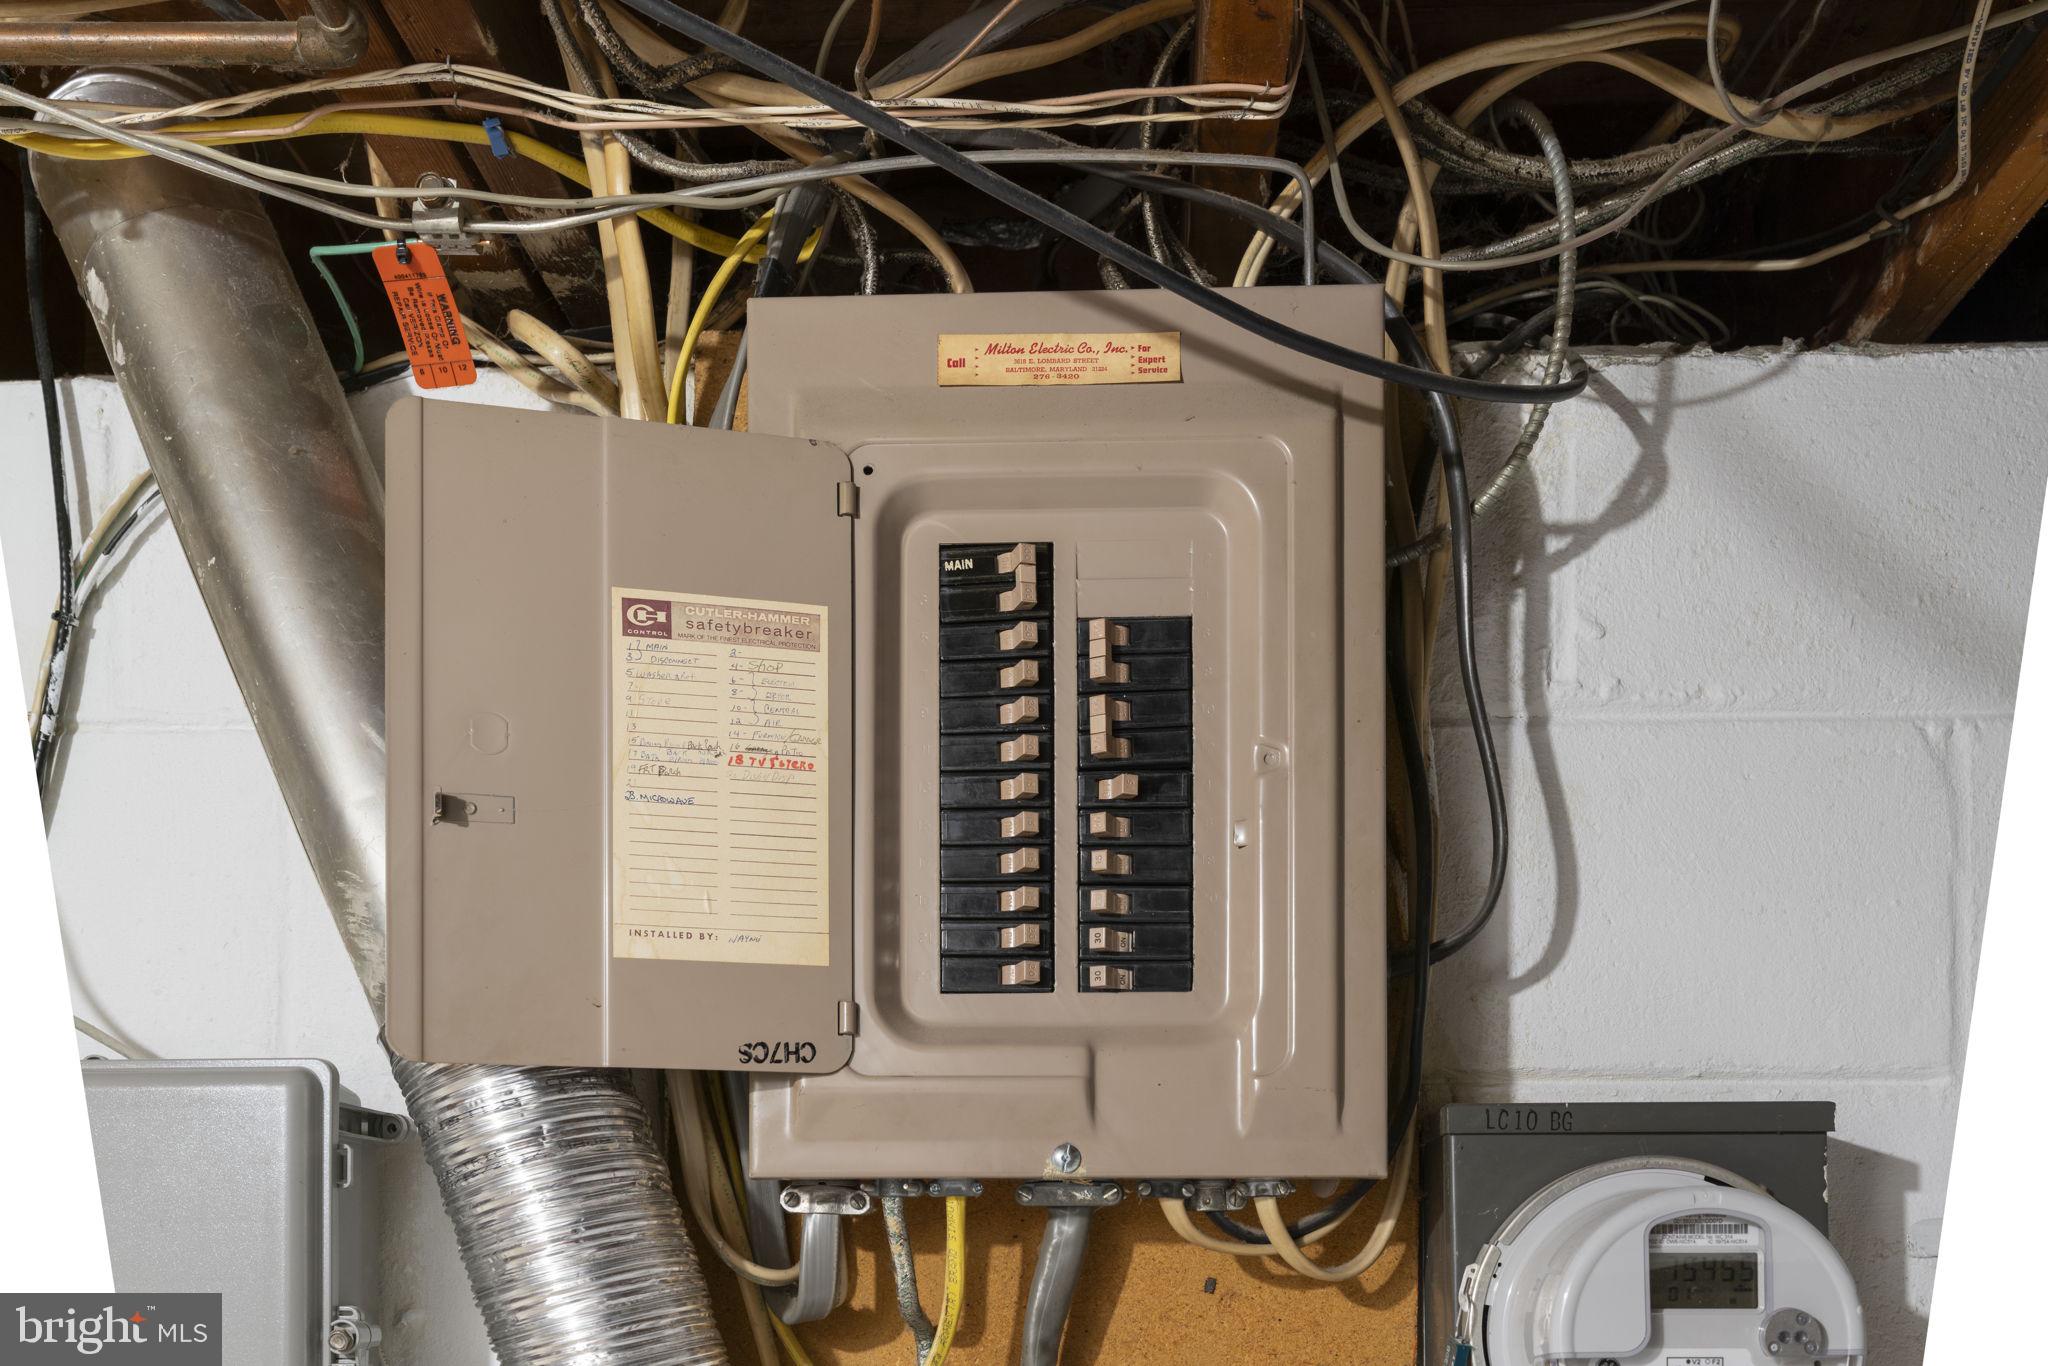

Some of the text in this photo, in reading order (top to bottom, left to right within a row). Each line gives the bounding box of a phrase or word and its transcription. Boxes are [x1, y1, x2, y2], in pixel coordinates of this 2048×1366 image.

[412, 298, 427, 331] Removed
[437, 293, 461, 346] WARNING
[391, 290, 419, 357] REPAIR SERVICE
[408, 313, 424, 348] VERIZON
[984, 342, 1129, 356] Milton Electric Co., Inc.
[1138, 344, 1151, 353] For
[947, 358, 966, 368] Call
[1138, 355, 1166, 366] Expert
[438, 366, 449, 374] 10
[457, 364, 468, 372] 12
[1138, 365, 1168, 374] Service
[944, 559, 974, 572] MAIN
[685, 606, 811, 627] CUTLER-HAMMER
[627, 628, 669, 637] CONTROL
[685, 619, 813, 640] safetybreaker
[645, 643, 669, 651] MAIN
[677, 632, 696, 640] MARK
[741, 637, 778, 646] ELECTRICAL
[778, 640, 817, 650] PROTECTION
[727, 754, 744, 767] 18
[639, 793, 696, 805] MICROWAVE
[629, 929, 693, 940] INSTALLED
[1094, 932, 1127, 948] 30 ON
[1094, 970, 1126, 986] 30 ON
[738, 1041, 817, 1064] CH7CS
[1550, 1110, 1574, 1131] BG
